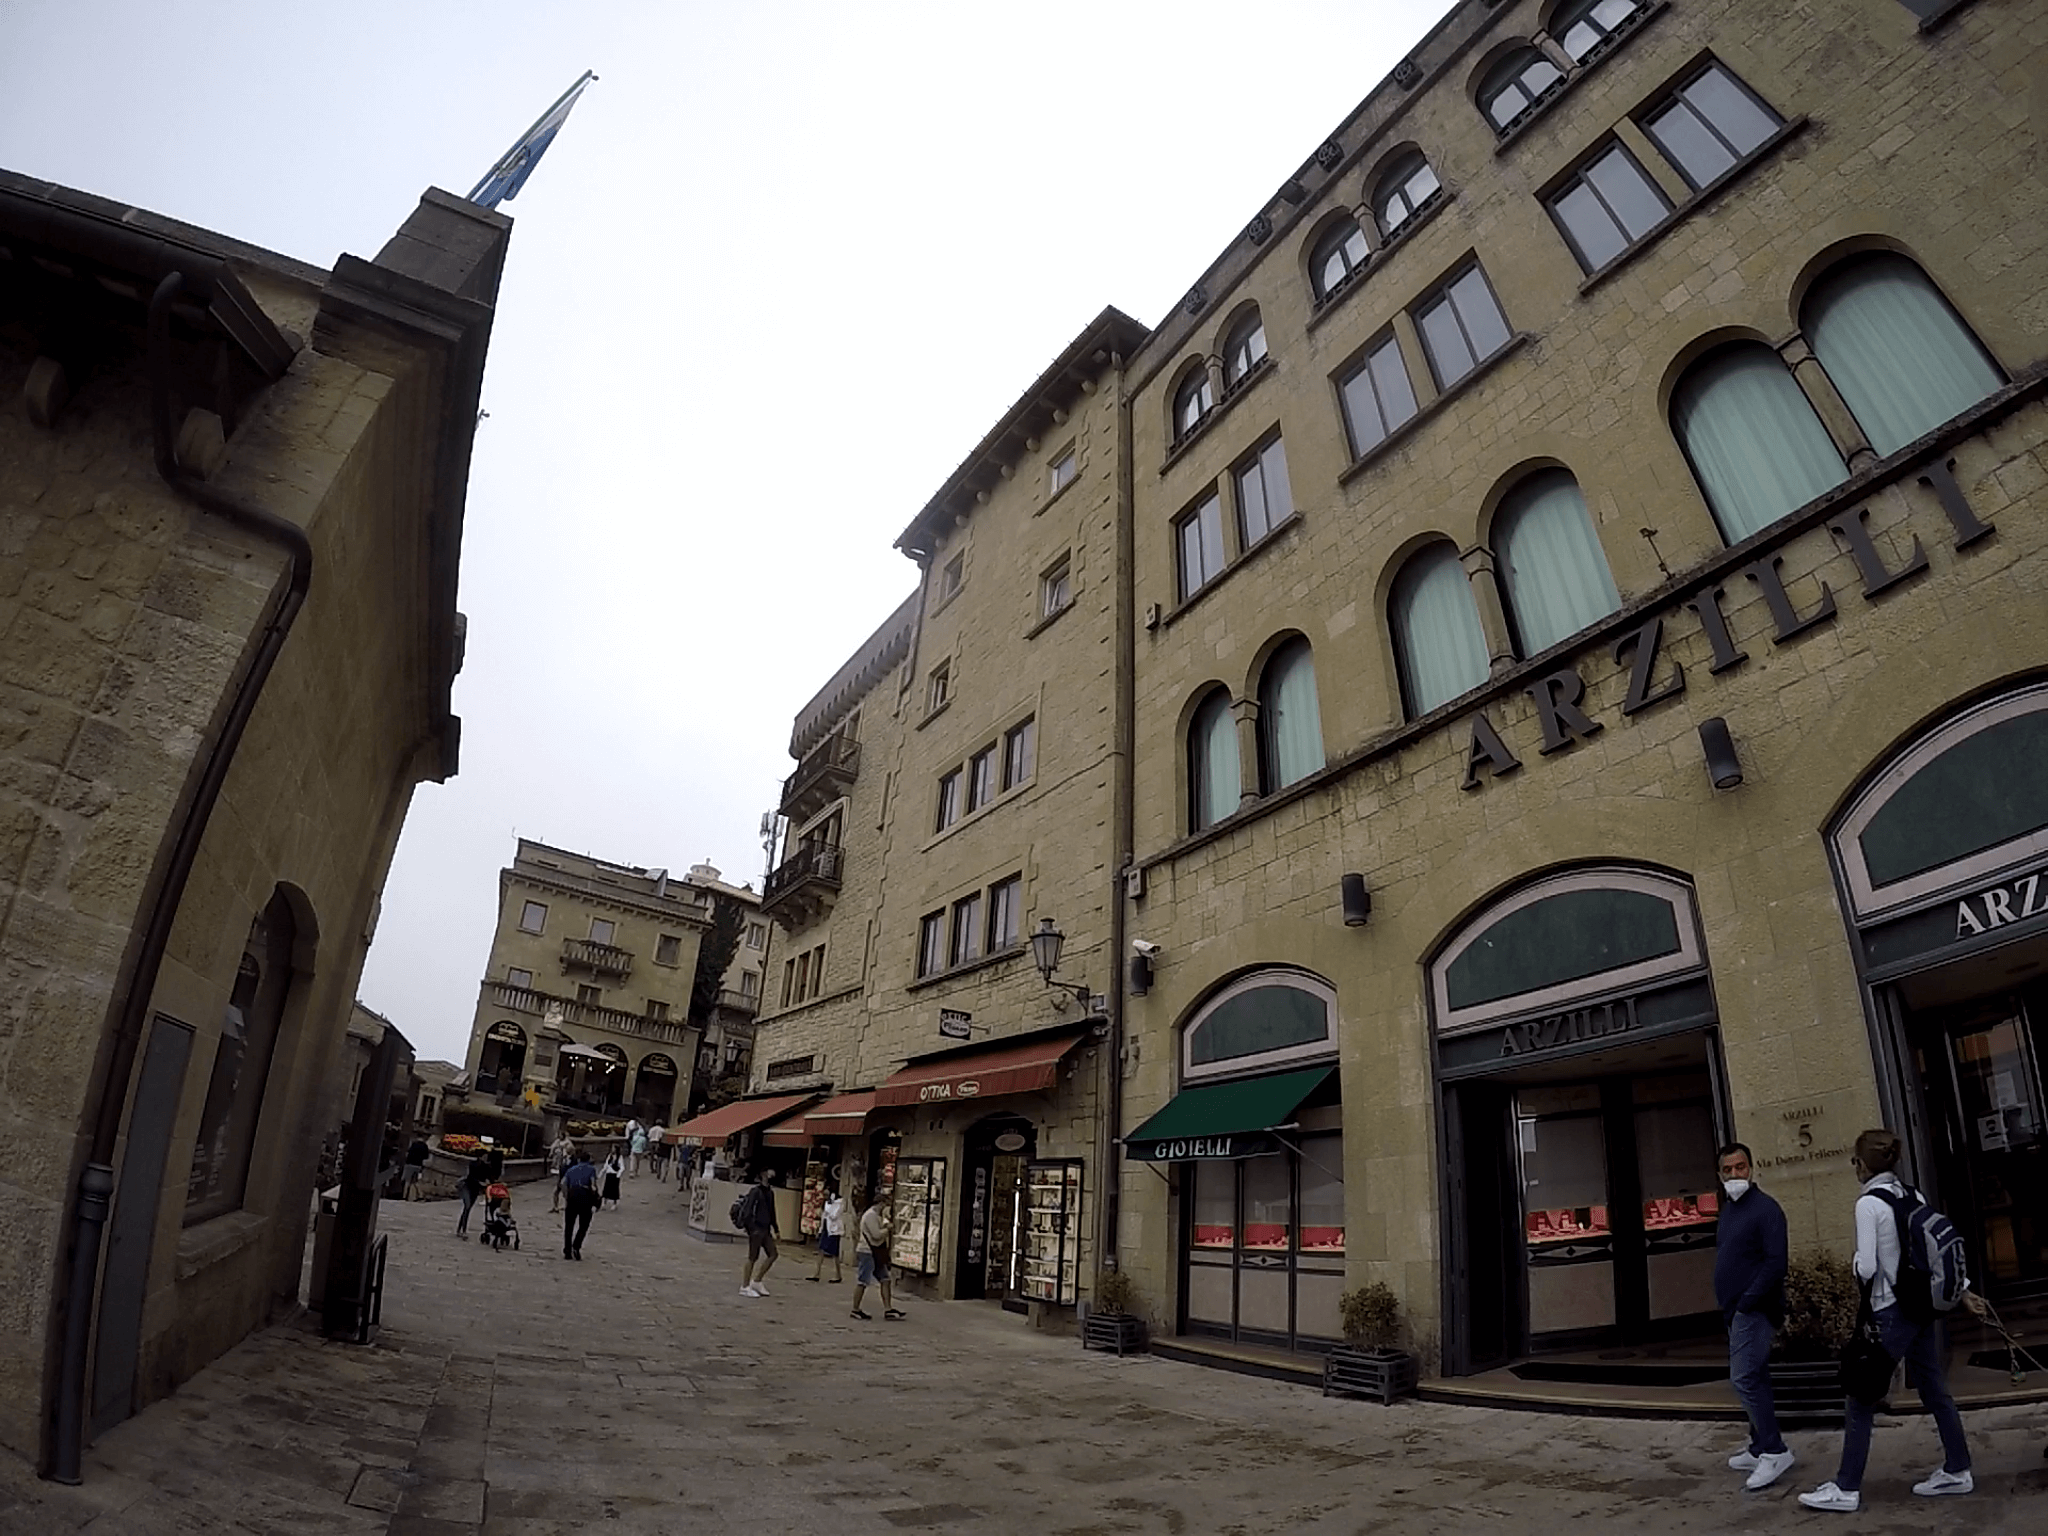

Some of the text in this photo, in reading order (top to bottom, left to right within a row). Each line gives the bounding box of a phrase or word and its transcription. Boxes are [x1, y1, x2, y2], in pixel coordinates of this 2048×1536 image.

[1461, 456, 1997, 791] ARZILLI
[1955, 870, 2048, 940] ARZ
[1500, 997, 1643, 1056] ARZILLI
[1154, 1137, 1232, 1159] GIOIELLI
[1798, 1123, 1814, 1148] 5
